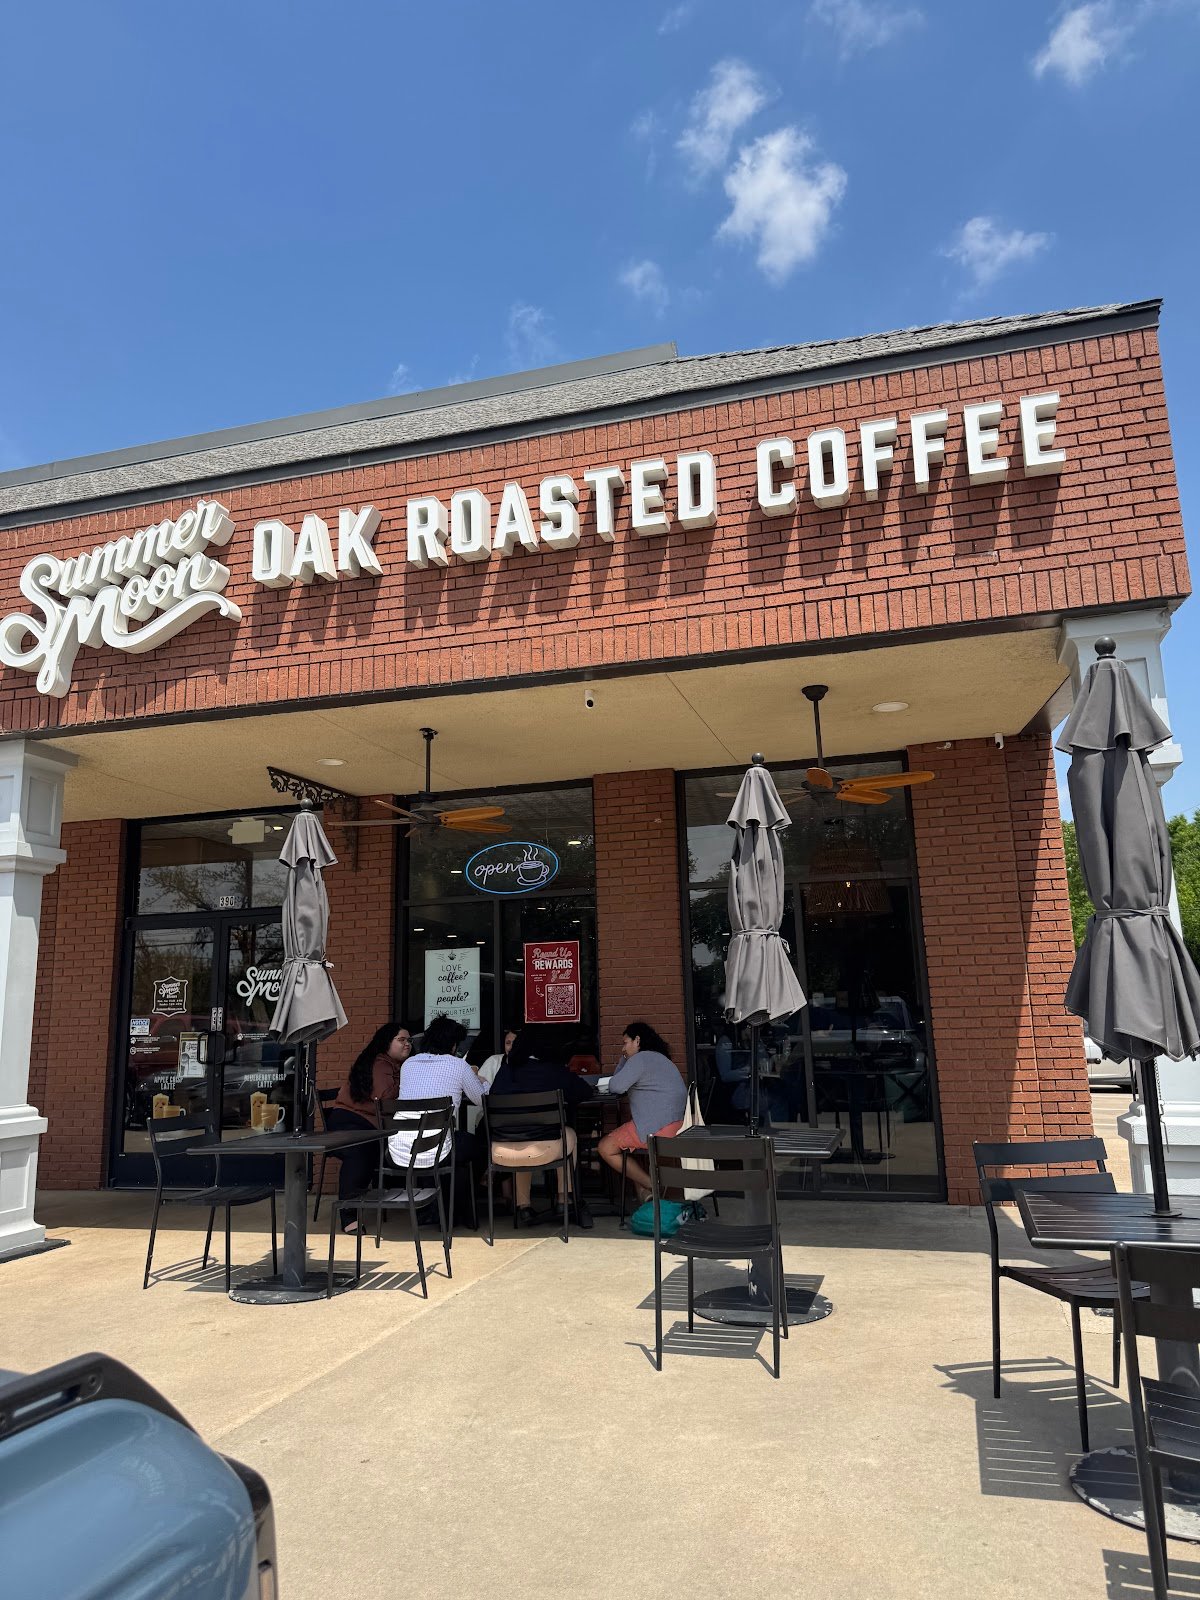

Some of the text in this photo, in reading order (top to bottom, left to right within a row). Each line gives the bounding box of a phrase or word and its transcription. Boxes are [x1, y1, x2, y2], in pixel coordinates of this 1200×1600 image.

[252, 391, 1066, 588] OAK ROASTED COFFEE
[0, 500, 236, 672] Summer
[37, 552, 242, 698] Moon
[474, 861, 518, 885] open
[559, 946, 573, 959] Up
[441, 964, 462, 972] LOVE
[534, 959, 573, 970] REWARDS
[236, 966, 283, 997] Summ
[437, 971, 469, 983] coffee?
[246, 981, 281, 1006] Mo
[441, 985, 462, 993] LOVE
[436, 992, 469, 1005] people?
[160, 1082, 176, 1091] LATTE
[257, 1080, 273, 1089] LATTE
